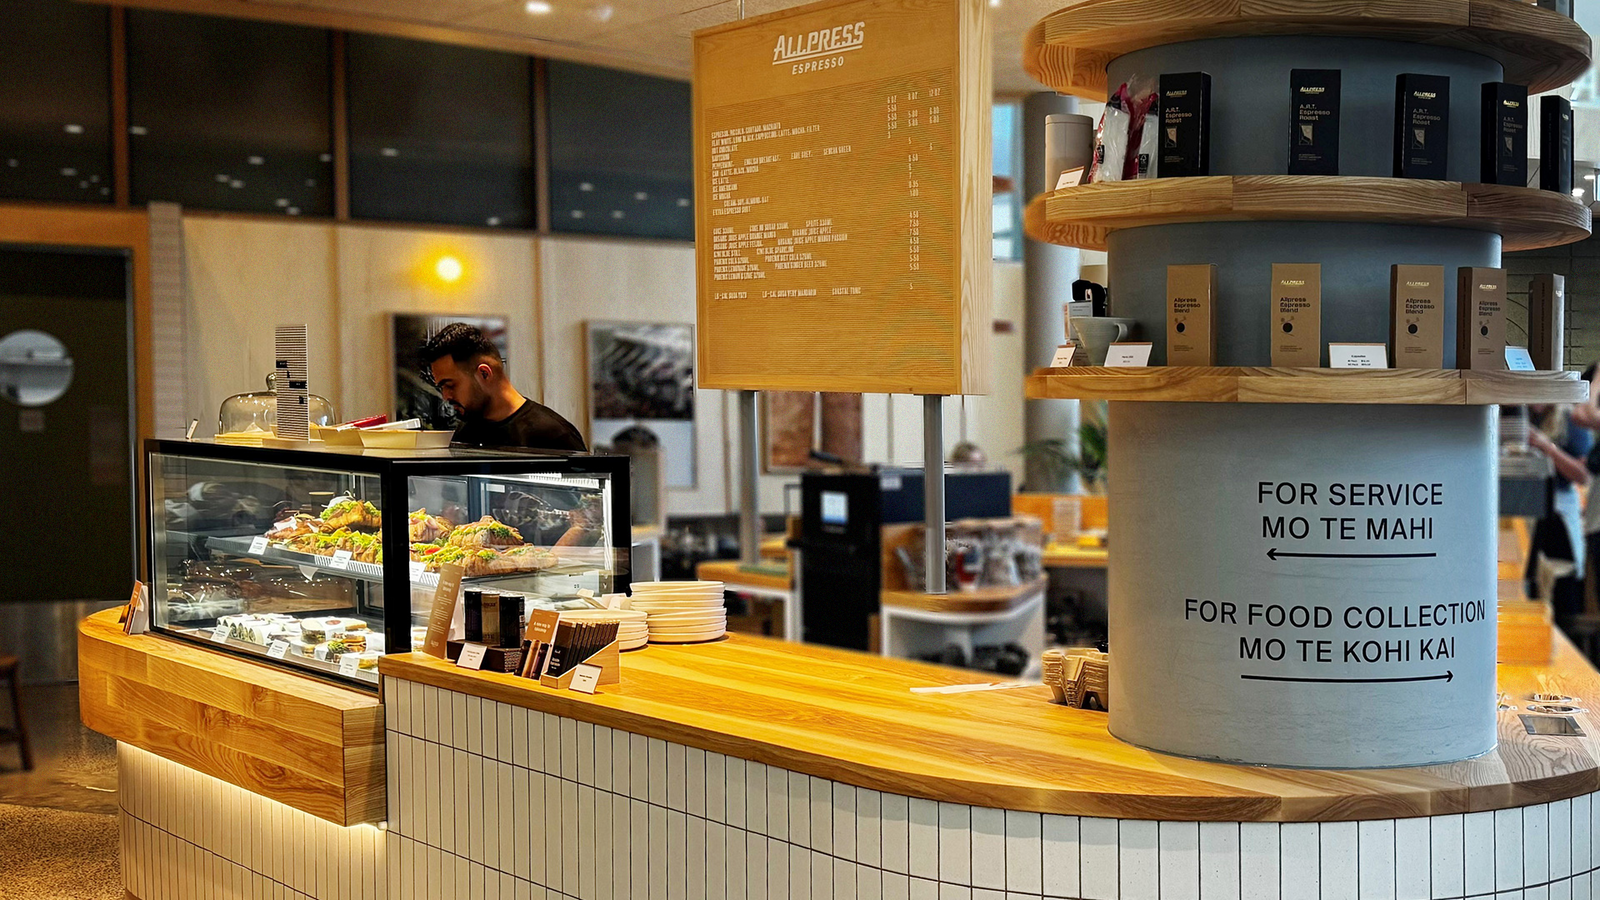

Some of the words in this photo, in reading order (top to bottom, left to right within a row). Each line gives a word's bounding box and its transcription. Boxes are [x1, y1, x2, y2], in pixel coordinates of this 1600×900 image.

[774, 22, 865, 60] ALLPRESS
[792, 56, 844, 75] ESPRESSO
[807, 124, 820, 132] FILTER
[791, 152, 801, 160] EARL
[824, 146, 838, 155] SENCHA
[838, 145, 851, 154] GREEN
[724, 206, 741, 215] ESPRESSO
[793, 237, 804, 245] JUICE
[805, 236, 817, 244] APPLE
[831, 234, 848, 242] PASSION
[808, 227, 819, 235] JUICE
[820, 226, 832, 234] APPLE
[1258, 482, 1318, 505] FOR
[1328, 483, 1443, 506] SERVICE
[1262, 516, 1310, 539] MO
[1320, 518, 1356, 540] TE
[1366, 517, 1433, 540] MAHI
[1185, 598, 1237, 624] FOR
[1248, 604, 1332, 628] FOOD
[1344, 600, 1485, 628] COLLECTION
[1240, 637, 1286, 661] MO
[1296, 640, 1332, 662] TE
[1344, 640, 1410, 663] KOHI
[1420, 637, 1454, 661] KAI
